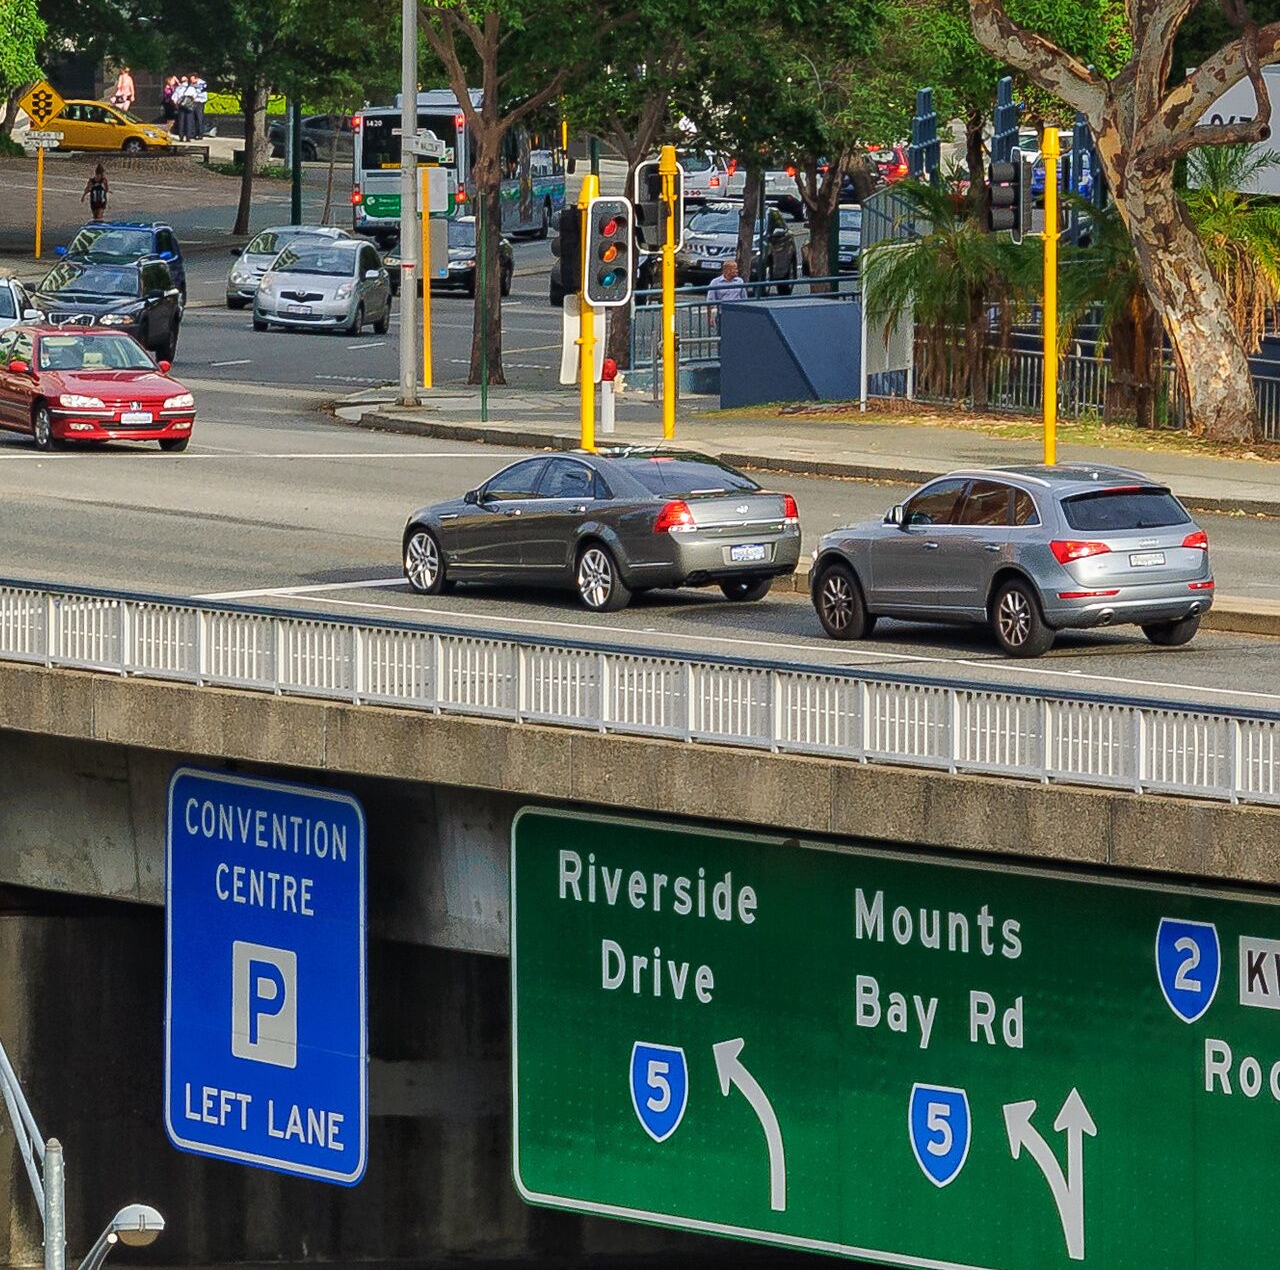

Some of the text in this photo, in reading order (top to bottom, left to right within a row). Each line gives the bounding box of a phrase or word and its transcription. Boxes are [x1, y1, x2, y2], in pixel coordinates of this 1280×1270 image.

[185, 797, 347, 862] CONVENTION
[215, 862, 314, 917] CENTRE
[558, 849, 758, 925] Riverside
[854, 887, 1023, 959] Mounts
[601, 938, 715, 1004] Drive
[1173, 936, 1202, 993] 2
[248, 959, 286, 1045] P
[855, 974, 1024, 1050] Bay Rd
[185, 1082, 344, 1152] LEFT LANE
[646, 1059, 672, 1113] 5
[925, 1101, 954, 1157] 5
